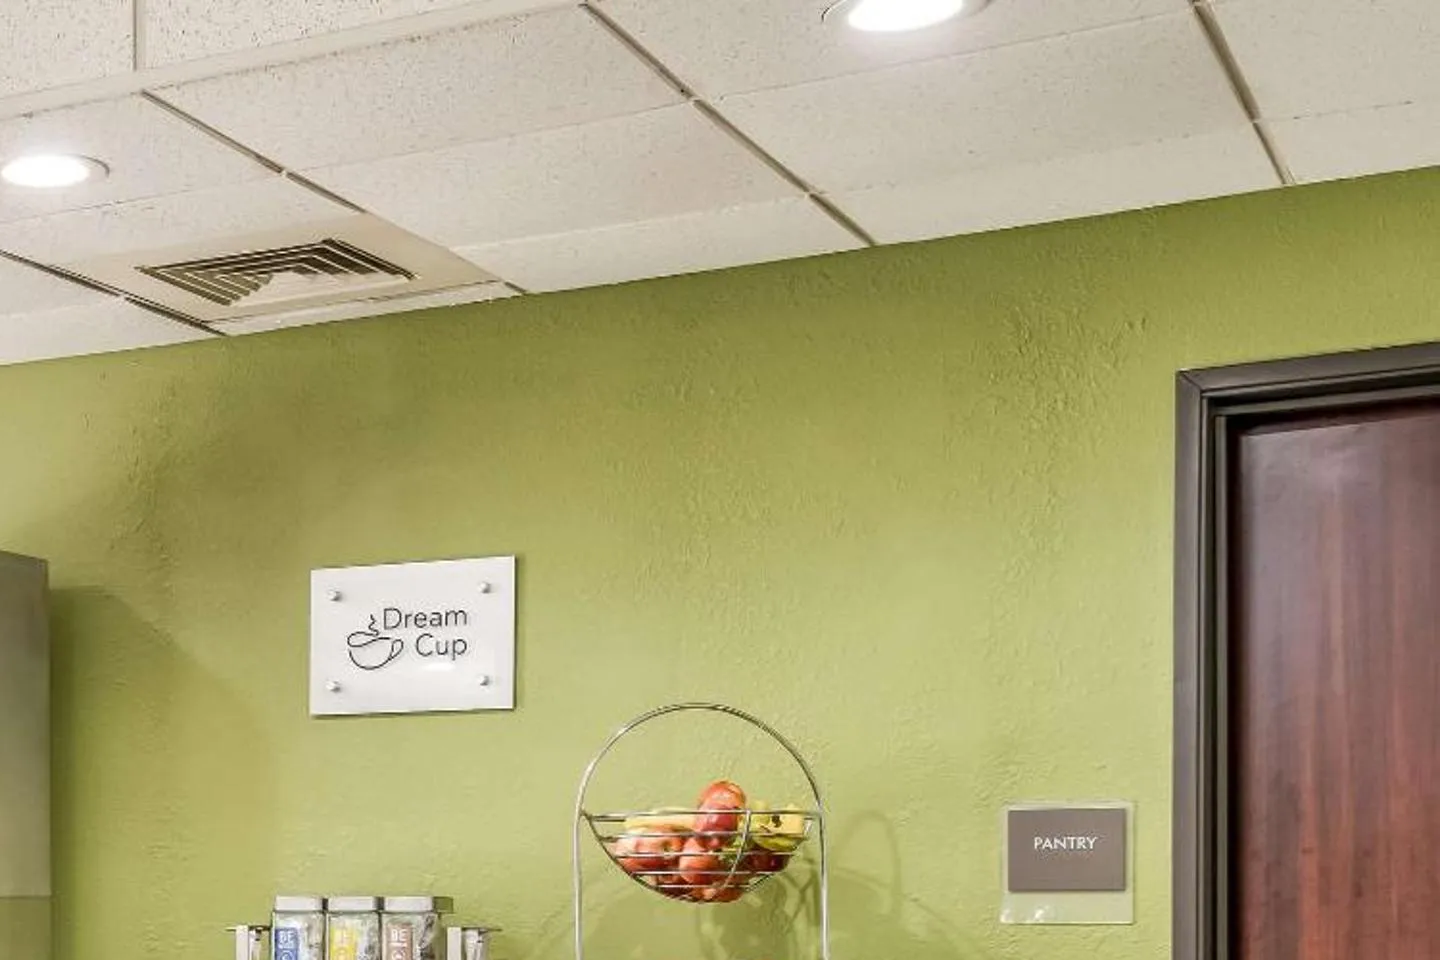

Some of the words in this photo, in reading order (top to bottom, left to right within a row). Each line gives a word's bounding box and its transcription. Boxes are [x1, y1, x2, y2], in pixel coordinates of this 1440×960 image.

[383, 607, 468, 630] Dream
[415, 633, 468, 660] Cup
[1033, 835, 1098, 850] PANTRY
